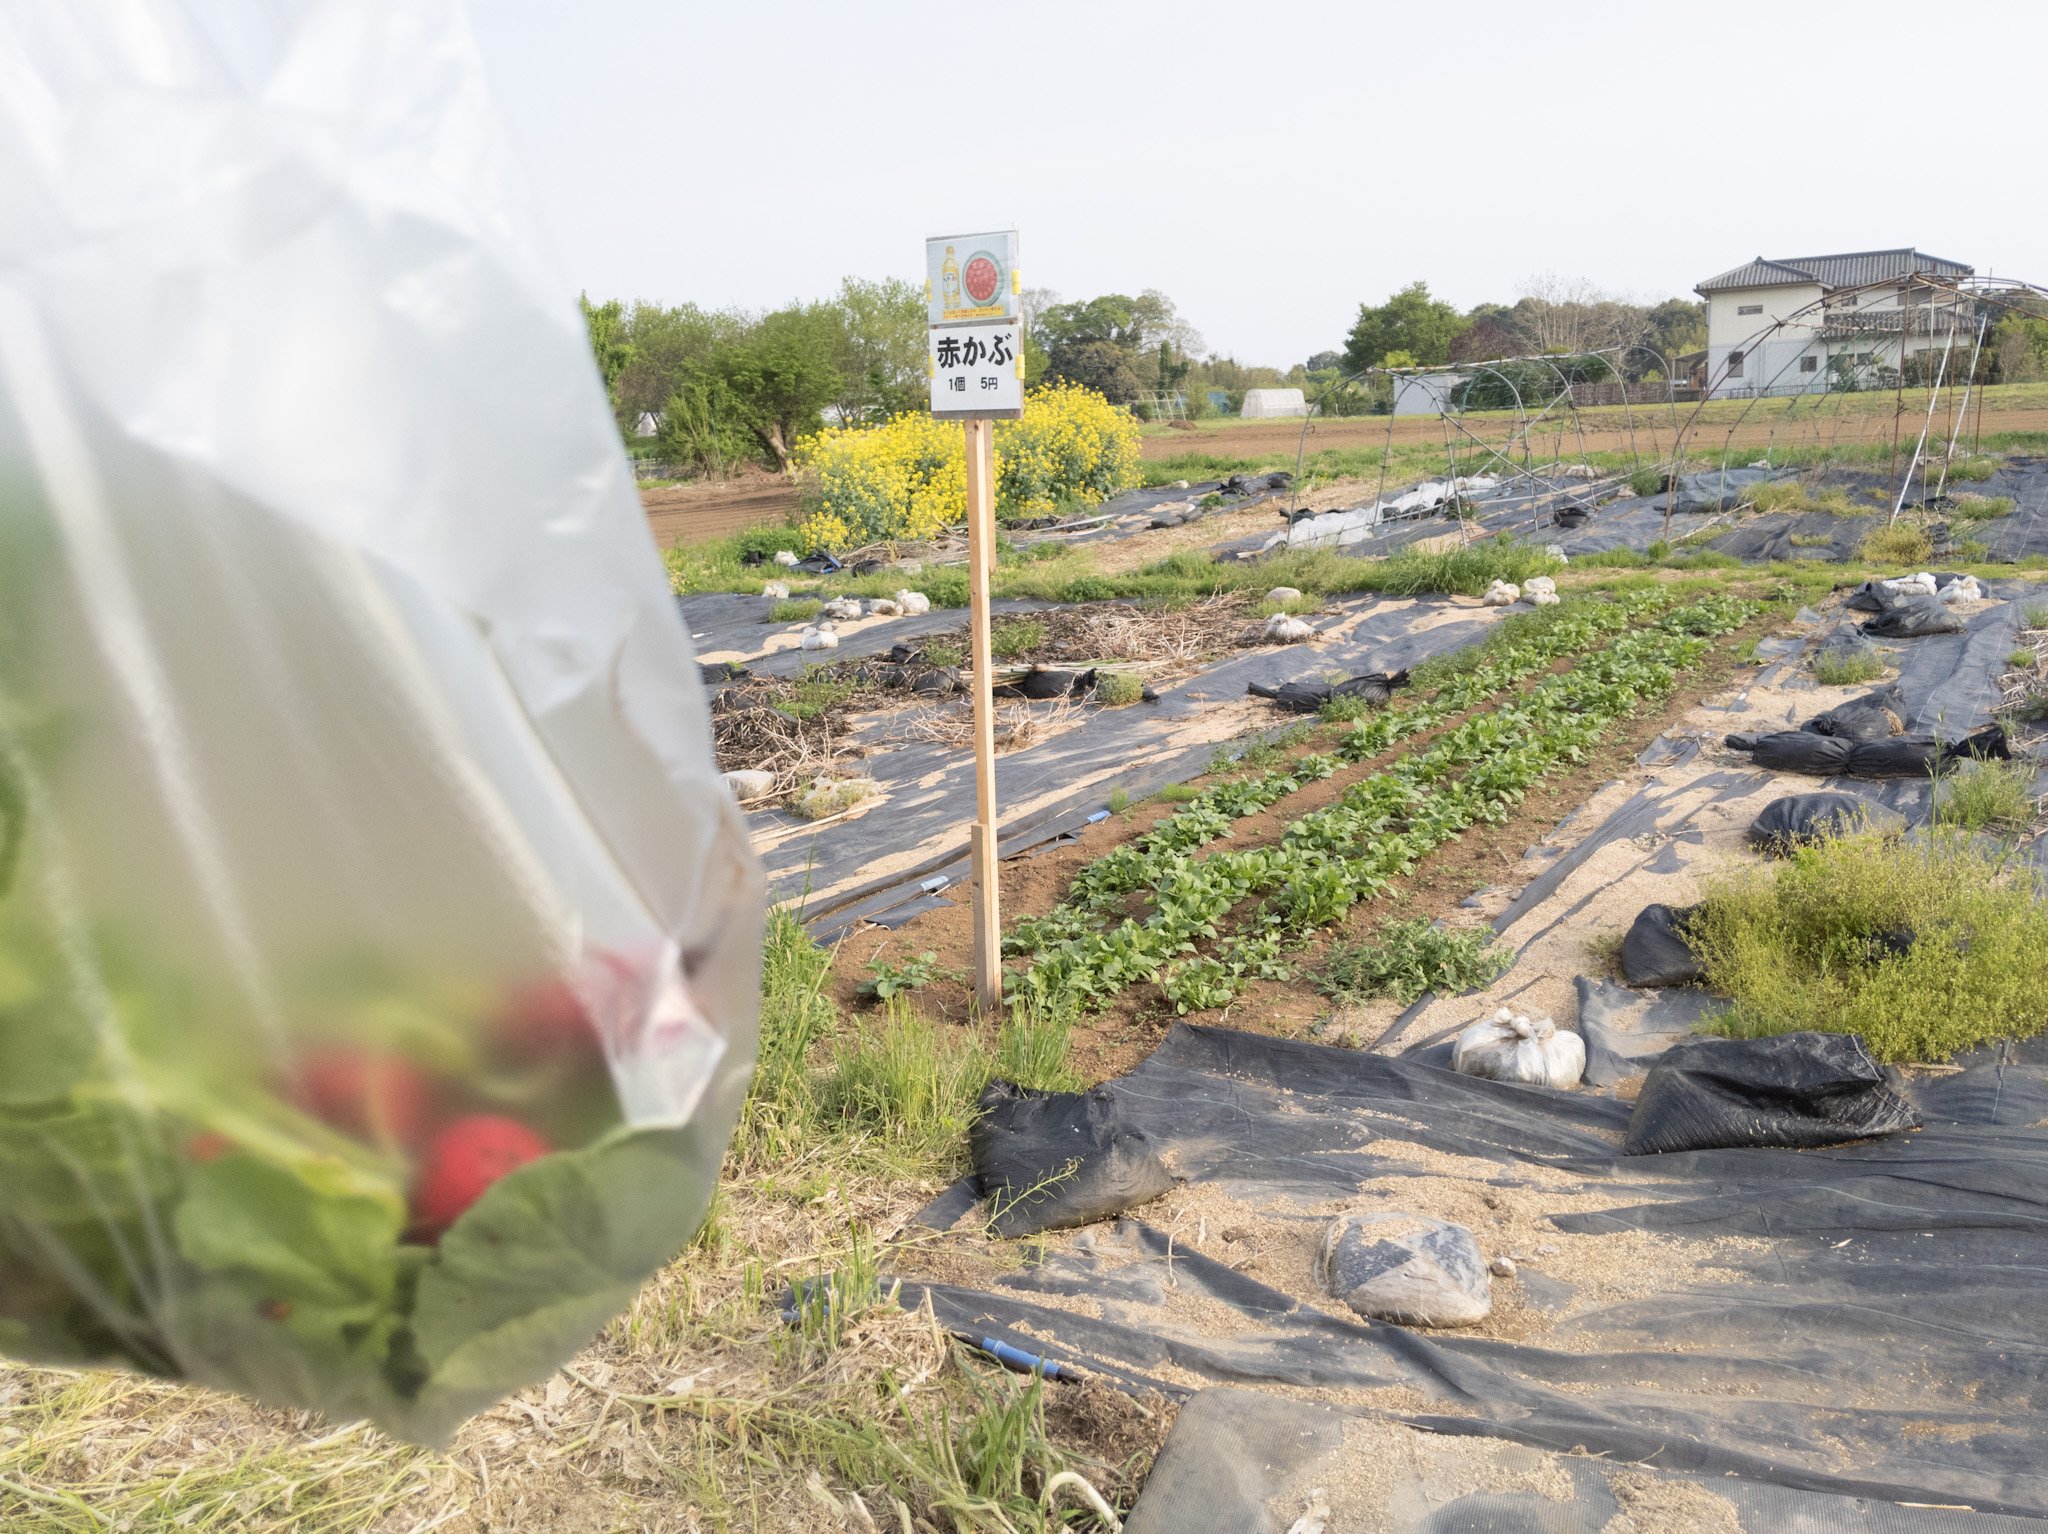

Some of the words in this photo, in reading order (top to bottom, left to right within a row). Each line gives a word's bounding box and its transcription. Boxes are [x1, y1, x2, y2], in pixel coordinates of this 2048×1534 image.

[937, 333, 1013, 369] 赤かぶ
[948, 376, 966, 392] 1個
[980, 376, 998, 390] 5円
